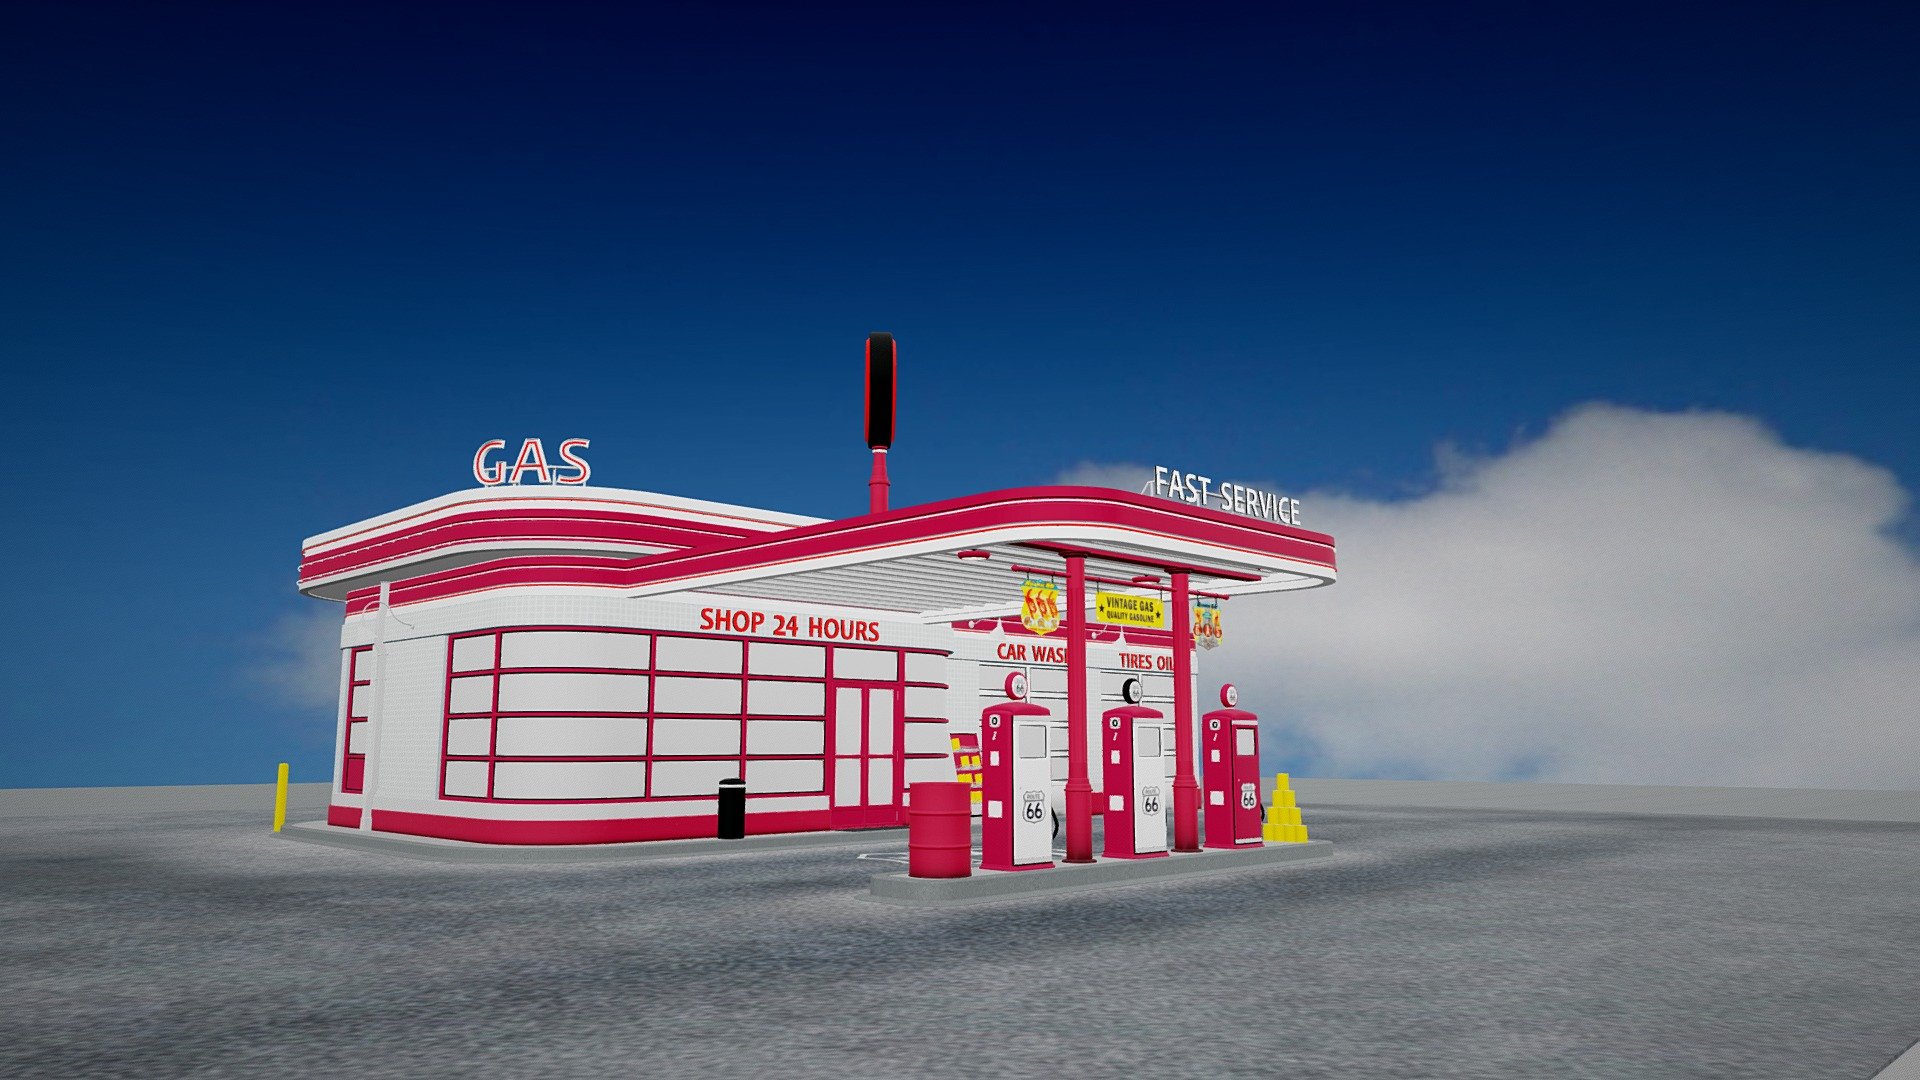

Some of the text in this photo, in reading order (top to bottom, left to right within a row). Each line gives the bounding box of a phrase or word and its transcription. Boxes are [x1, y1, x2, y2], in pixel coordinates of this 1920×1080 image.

[473, 438, 591, 484] GAS
[1155, 465, 1301, 526] FAST SERVICE
[1106, 596, 1154, 613] VINTAGE GAS
[700, 607, 880, 642] SHOP 24 HOURS
[1106, 610, 1154, 623] QUALITY GASOLINE
[997, 642, 1067, 664] CAR WAS
[1118, 652, 1153, 670] TIRES
[1145, 796, 1159, 812] 66
[1243, 792, 1255, 807] 66
[1026, 801, 1043, 819] 66
